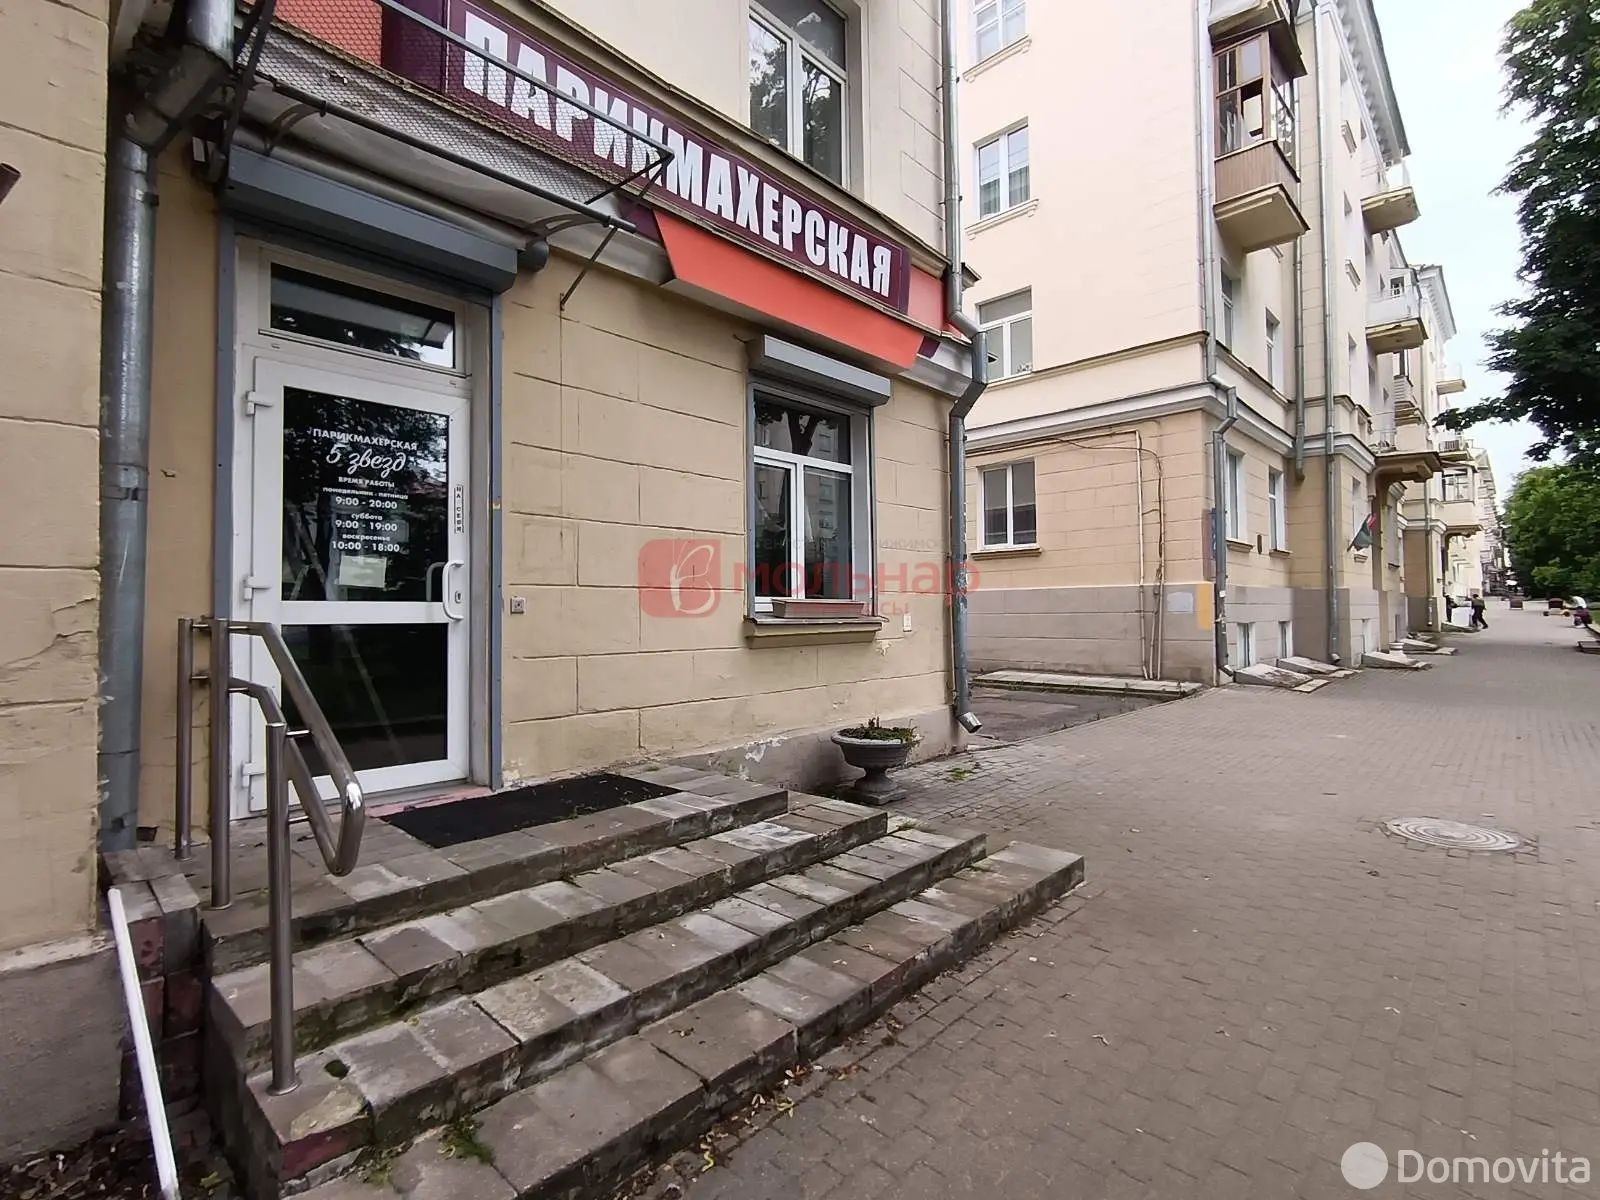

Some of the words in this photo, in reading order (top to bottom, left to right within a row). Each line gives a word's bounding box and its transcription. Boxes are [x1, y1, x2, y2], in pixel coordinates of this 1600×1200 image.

[463, 9, 892, 299] ПАРИКМАХЕРСКАЯ
[313, 428, 418, 450] ПАРИКМАХЕРСКАЯ
[326, 443, 348, 463] 5
[347, 449, 407, 478] звезд
[338, 477, 363, 485] ВРЕМЯ
[366, 480, 395, 488] РАБОТЫ
[323, 487, 374, 496] понедельник
[378, 492, 408, 500] пятница
[335, 496, 359, 506] 9:00
[369, 499, 398, 509] 20:00
[335, 519, 359, 529] 9:00
[370, 522, 398, 531] 19:00
[342, 534, 391, 542] воскресенье
[332, 541, 361, 550] 10:00
[372, 543, 400, 552] 18:00
